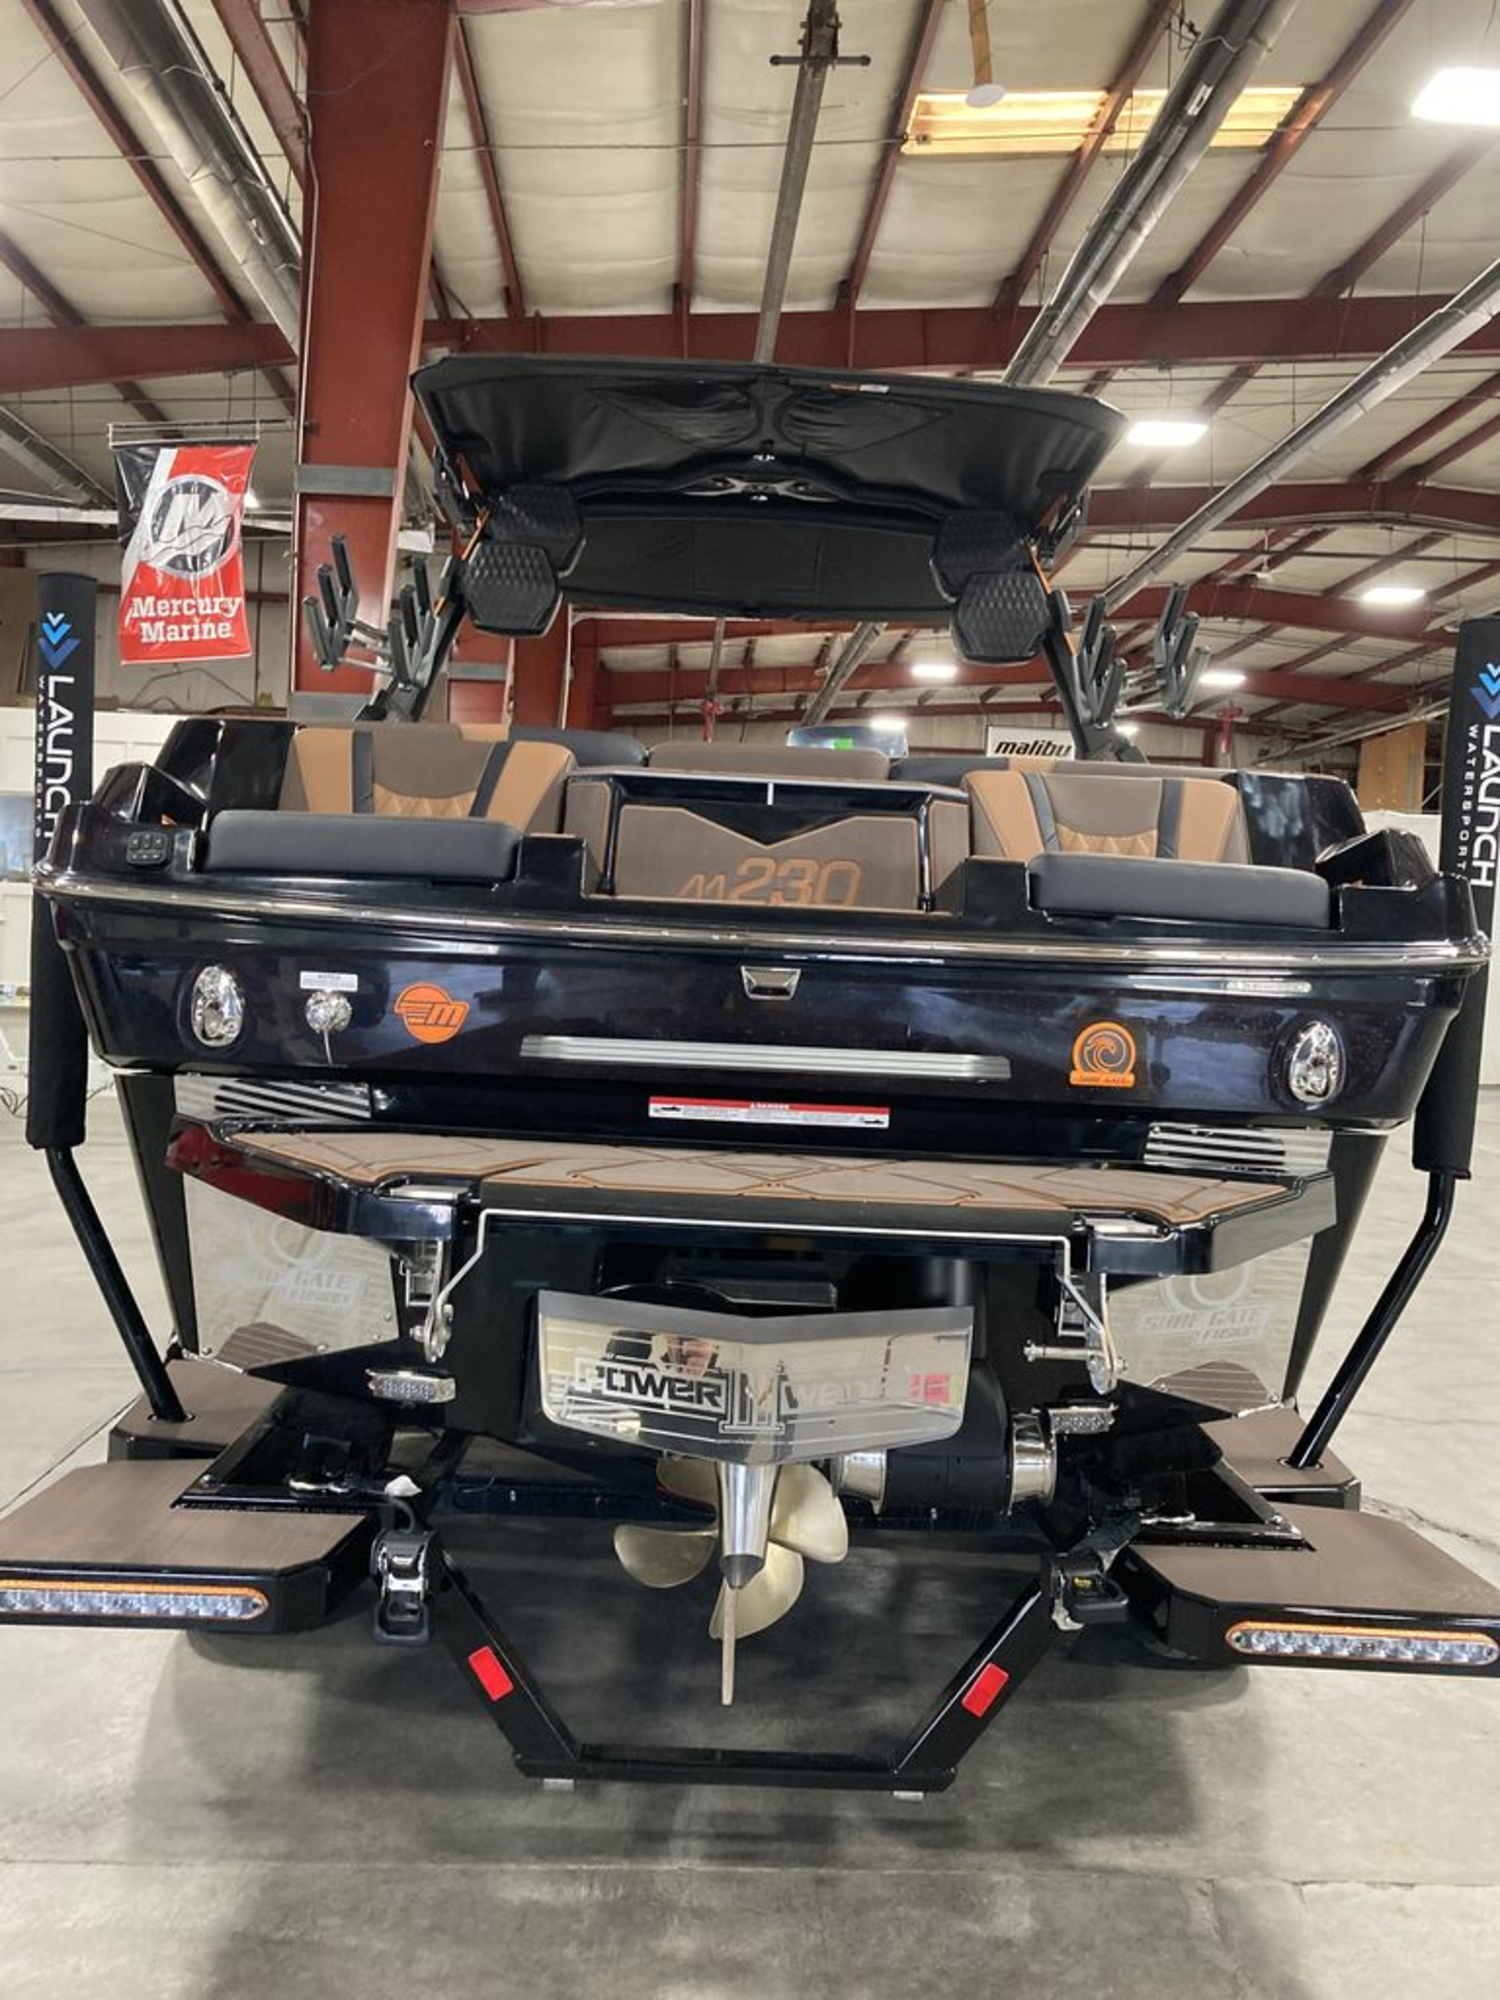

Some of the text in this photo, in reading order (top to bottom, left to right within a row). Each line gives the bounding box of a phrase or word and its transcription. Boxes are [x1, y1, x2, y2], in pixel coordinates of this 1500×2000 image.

[131, 597, 243, 619] Mercury
[140, 620, 232, 643] Marine
[995, 740, 1073, 756] malibu
